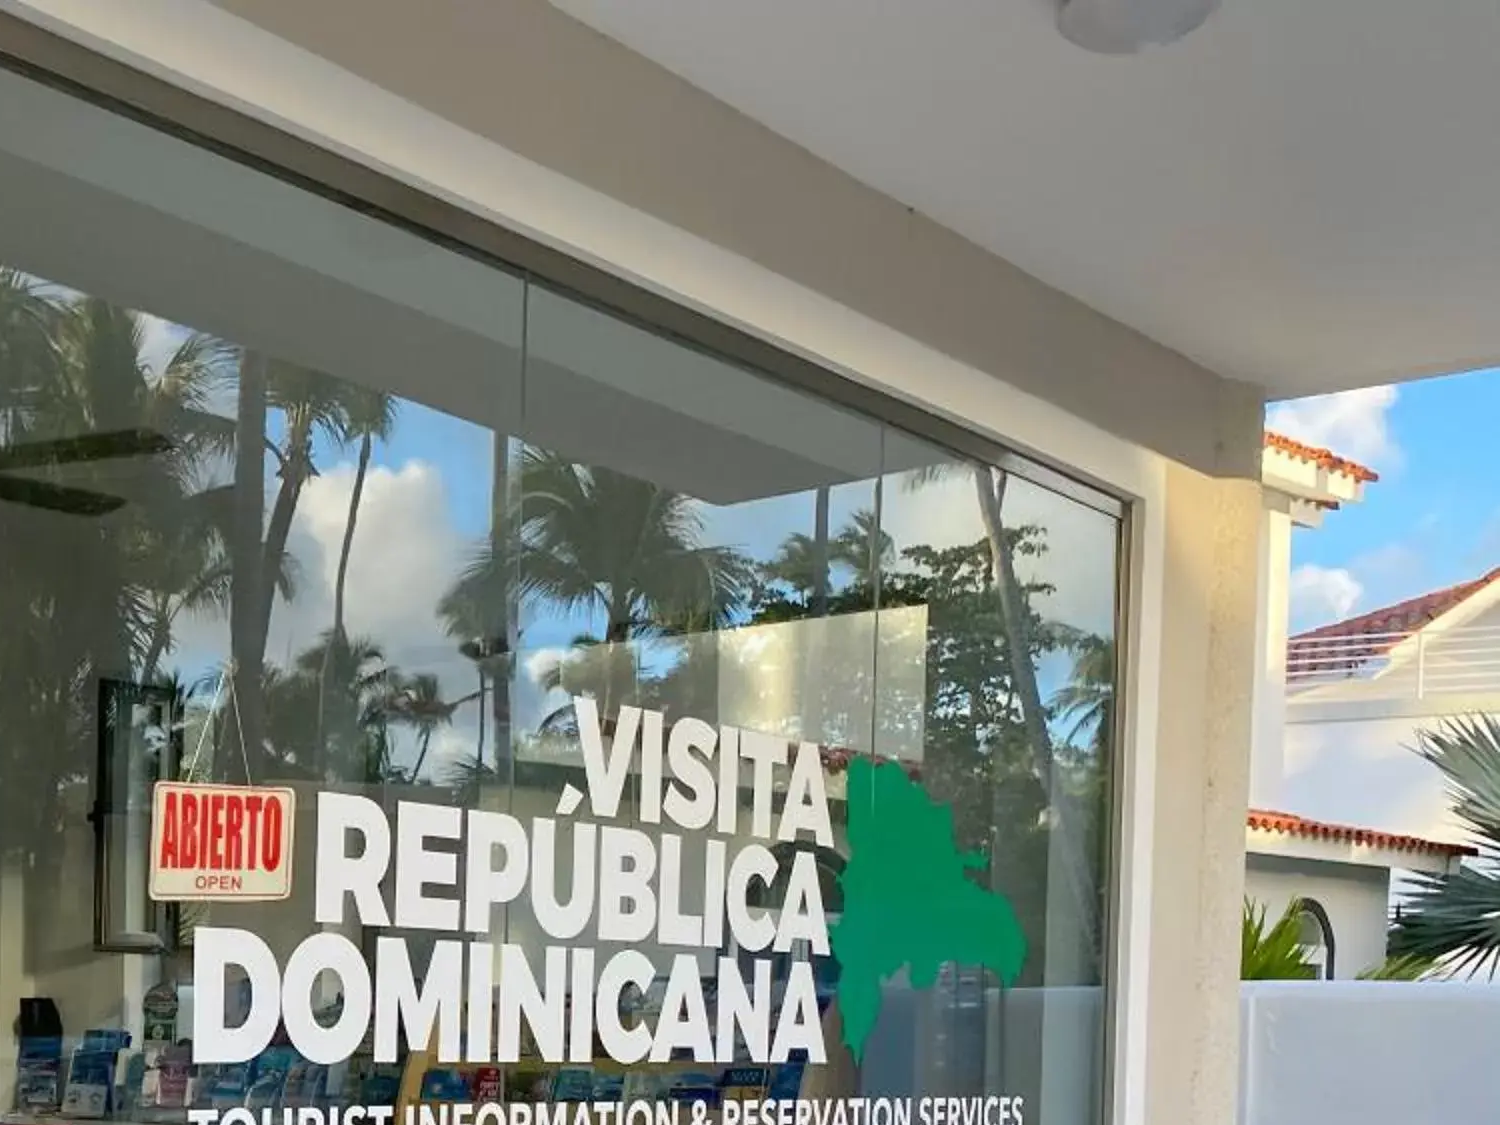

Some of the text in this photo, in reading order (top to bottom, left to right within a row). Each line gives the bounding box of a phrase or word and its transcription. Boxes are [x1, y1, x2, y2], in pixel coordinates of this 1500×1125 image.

[160, 791, 283, 872] ABIERTO
[574, 696, 834, 848] VISITA
[195, 875, 243, 890] OPEN
[315, 783, 831, 957] REPÚBLICA
[192, 927, 829, 1065] DOMINICANA
